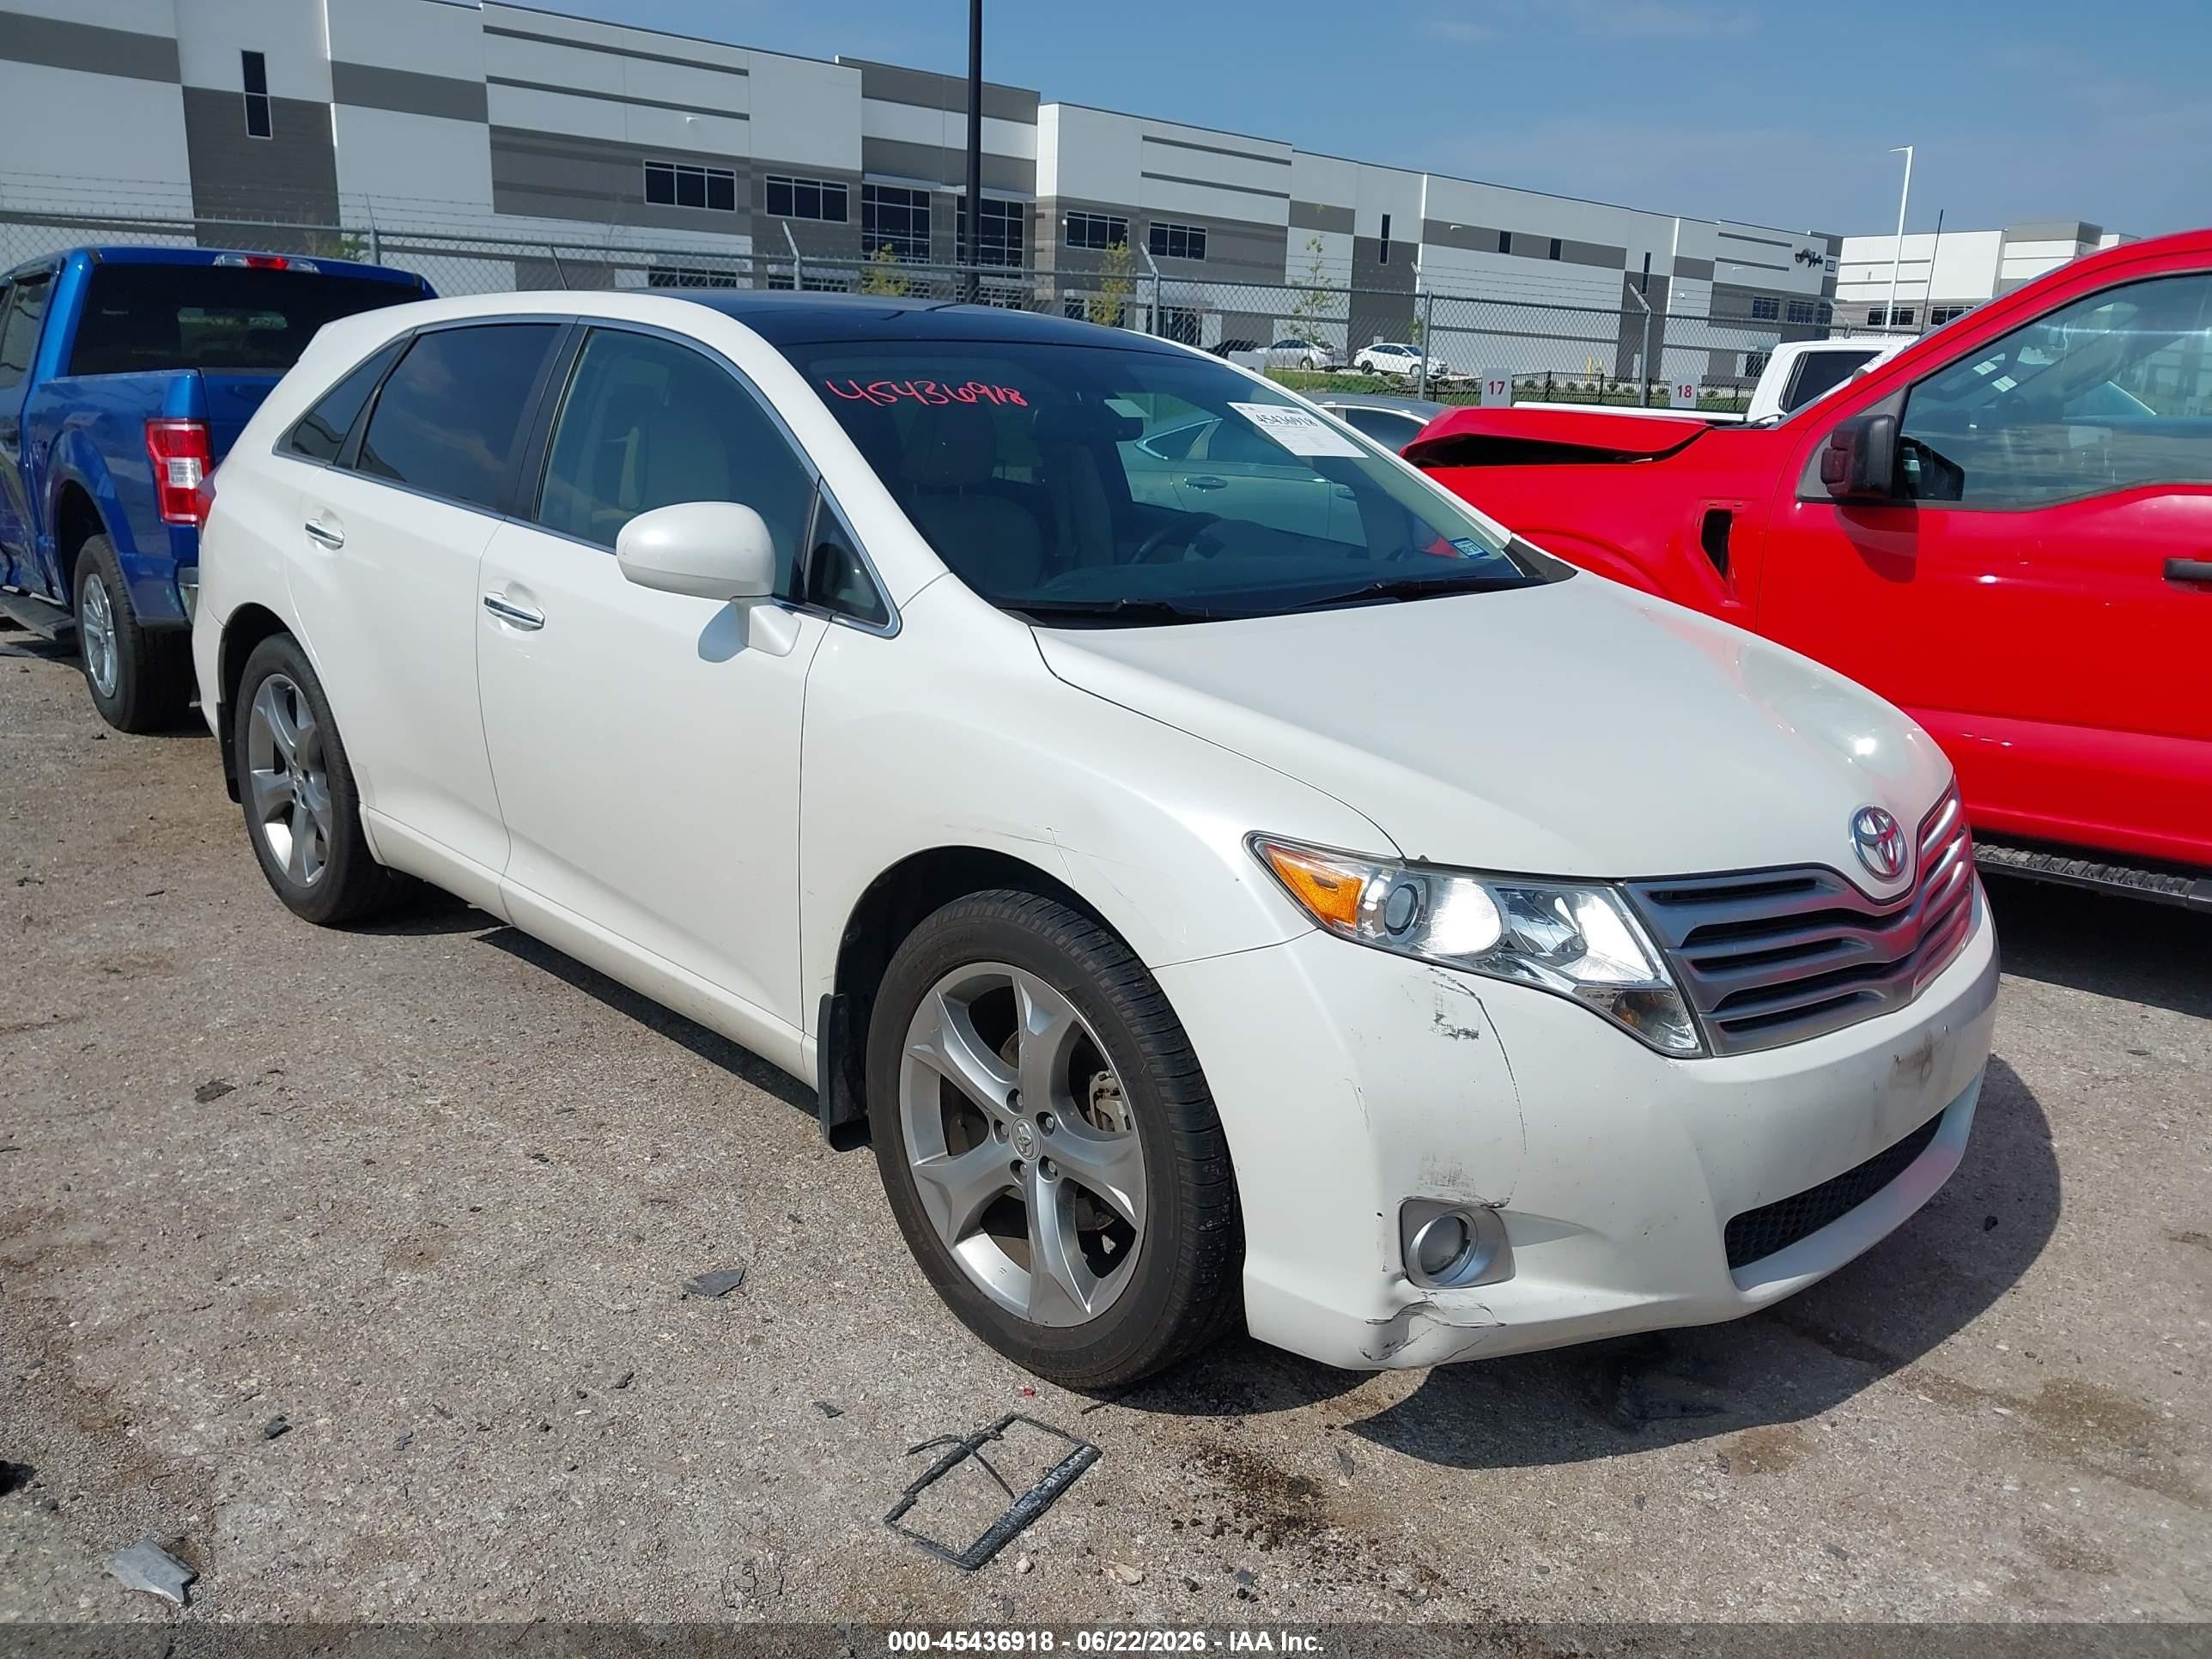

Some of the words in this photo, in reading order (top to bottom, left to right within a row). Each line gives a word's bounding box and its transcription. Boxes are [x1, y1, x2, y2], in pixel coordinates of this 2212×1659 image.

[824, 380, 1028, 407] 45436918
[1488, 380, 1505, 395] 17
[1677, 384, 1692, 398] 18
[1255, 413, 1319, 428] 45436918
